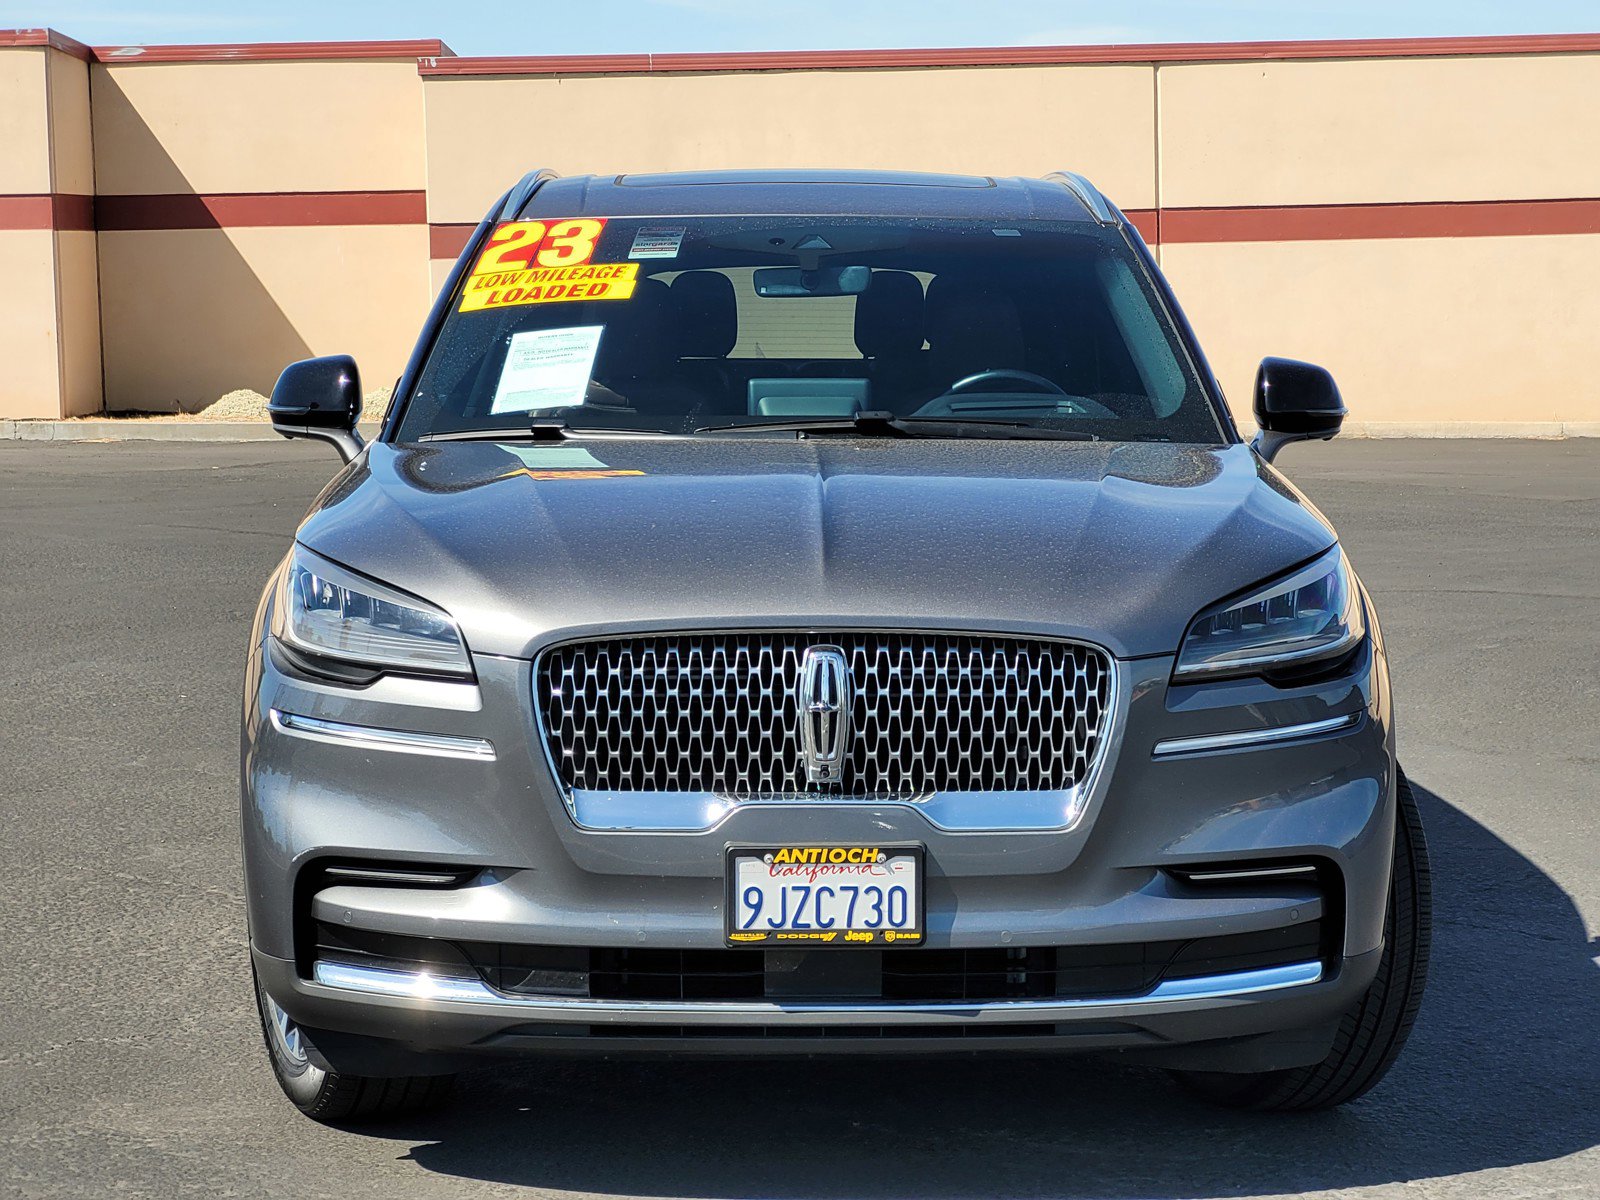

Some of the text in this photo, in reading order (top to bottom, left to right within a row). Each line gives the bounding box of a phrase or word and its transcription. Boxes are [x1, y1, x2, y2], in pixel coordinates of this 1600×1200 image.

[473, 219, 604, 276] 23
[473, 265, 627, 290] LOW MILEAGE
[485, 282, 610, 306] LOADED
[773, 848, 879, 864] ANTIOCH
[769, 864, 886, 884] California
[743, 886, 908, 929] 9JZC730
[844, 930, 874, 943] Jeep
